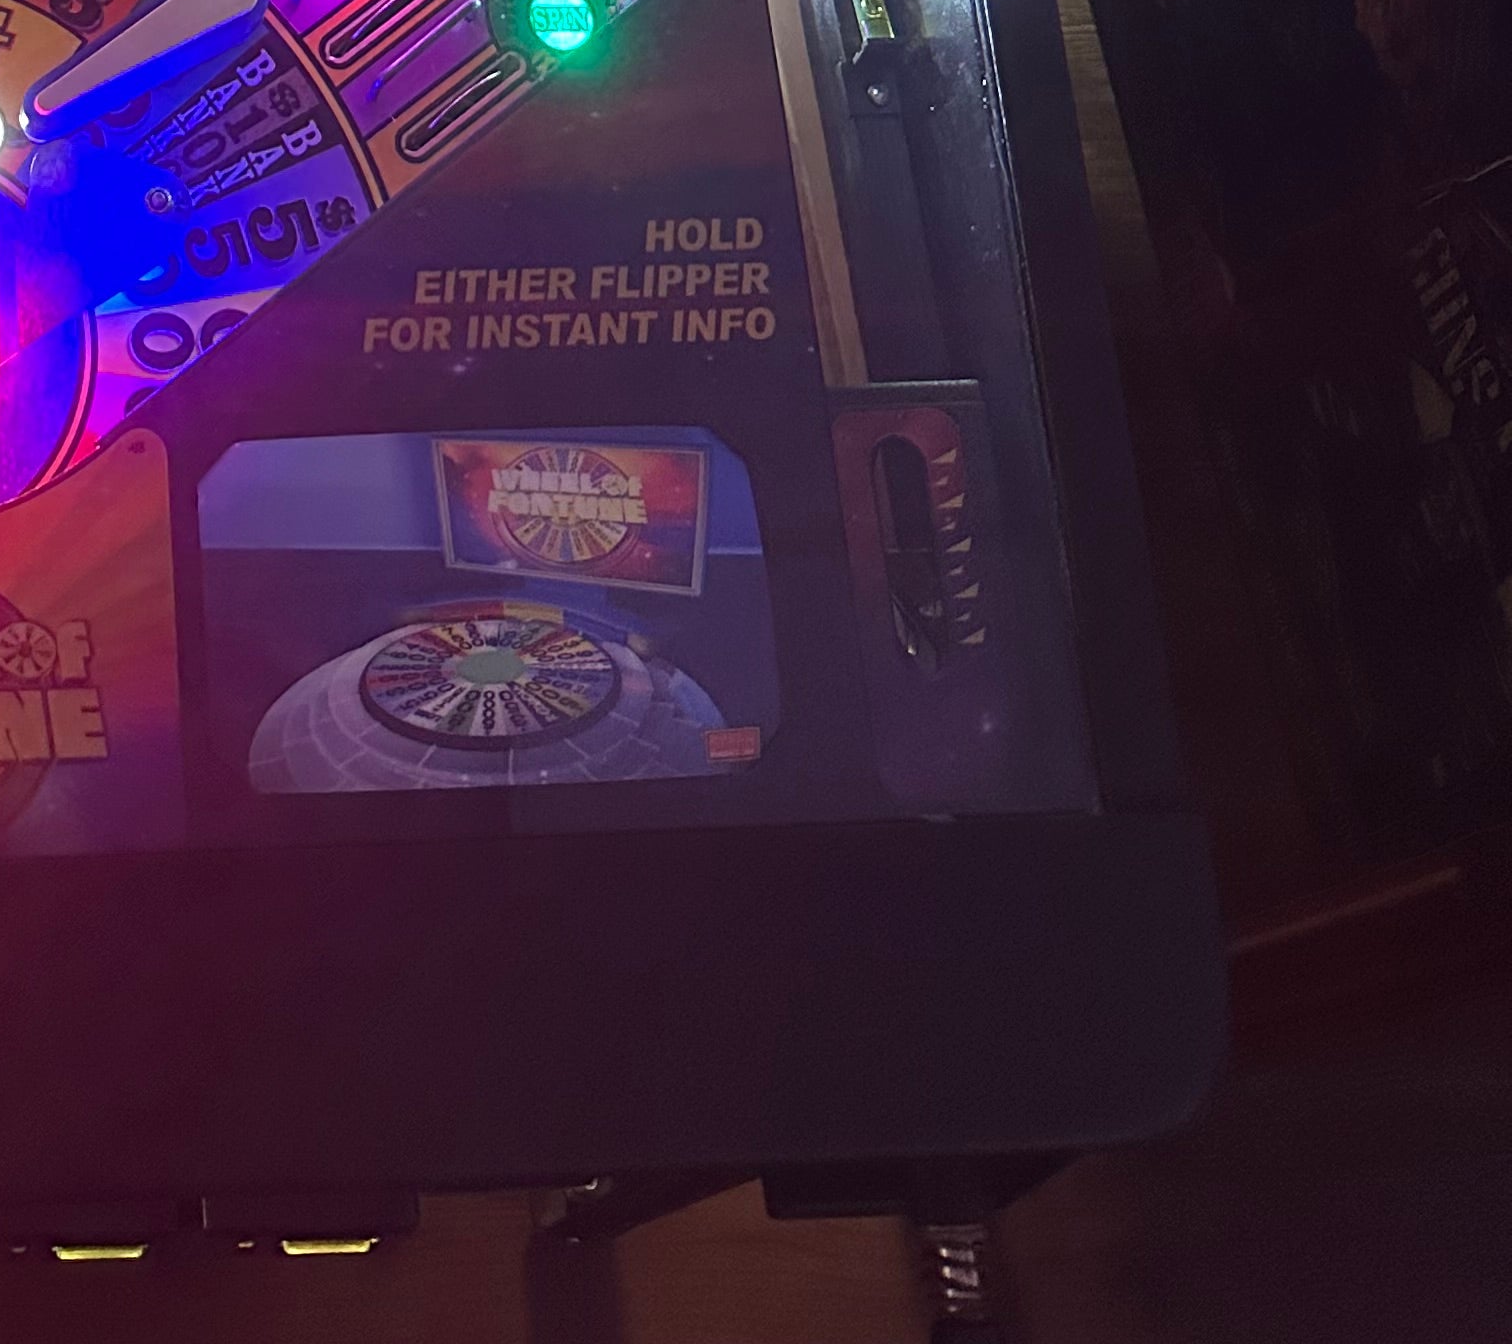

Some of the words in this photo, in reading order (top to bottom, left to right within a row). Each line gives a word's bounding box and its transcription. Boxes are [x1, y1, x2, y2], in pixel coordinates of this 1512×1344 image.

[531, 6, 588, 32] SPIN
[644, 217, 764, 253] HOLD
[414, 267, 576, 304] EITHER
[590, 262, 770, 300] FLIPPER
[362, 316, 452, 353] FOR
[465, 312, 658, 349] INSTANT
[672, 307, 776, 342] INFO
[491, 466, 601, 496] WHEEL
[488, 490, 650, 525] FORTUNE
